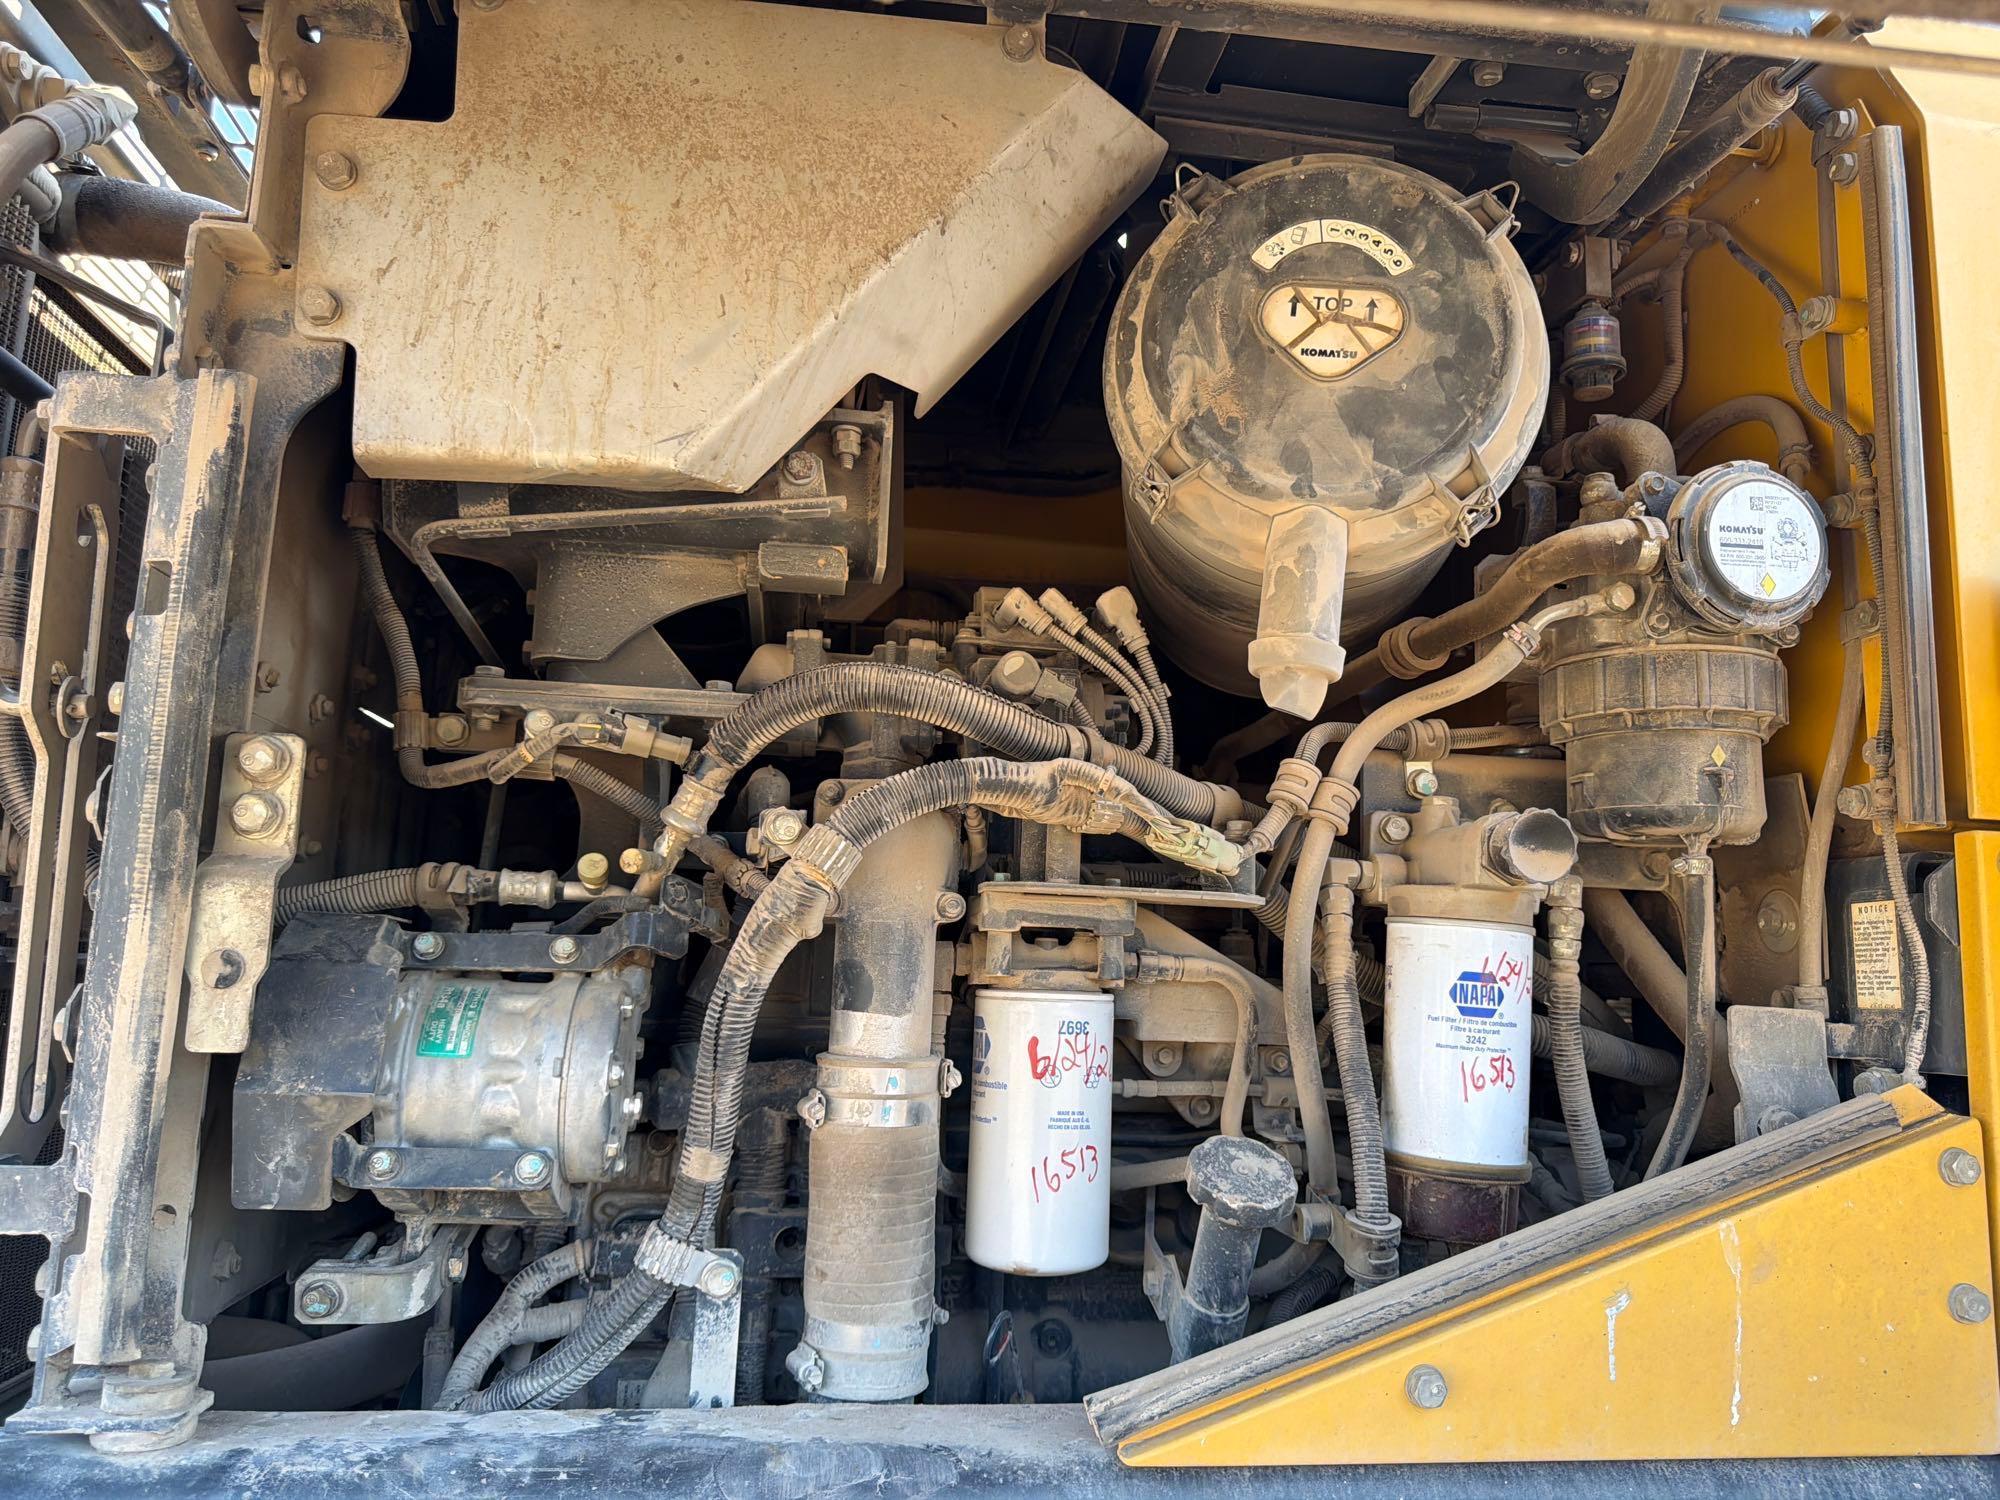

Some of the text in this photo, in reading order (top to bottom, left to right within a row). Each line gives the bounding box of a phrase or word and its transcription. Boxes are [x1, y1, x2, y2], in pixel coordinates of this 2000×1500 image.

[1313, 296, 1353, 312] TOP
[1300, 347, 1358, 359] KOMATSU
[1719, 524, 1764, 535] KOMATSU
[1858, 905, 1888, 915] NOTICE
[1456, 984, 1498, 1007] NAPA
[428, 1021, 438, 1041] DUTY
[435, 1019, 446, 1044] HEAVY
[1058, 1020, 1090, 1035] 3697
[1466, 1036, 1487, 1045] 3242
[1032, 1145, 1098, 1203] 16513
